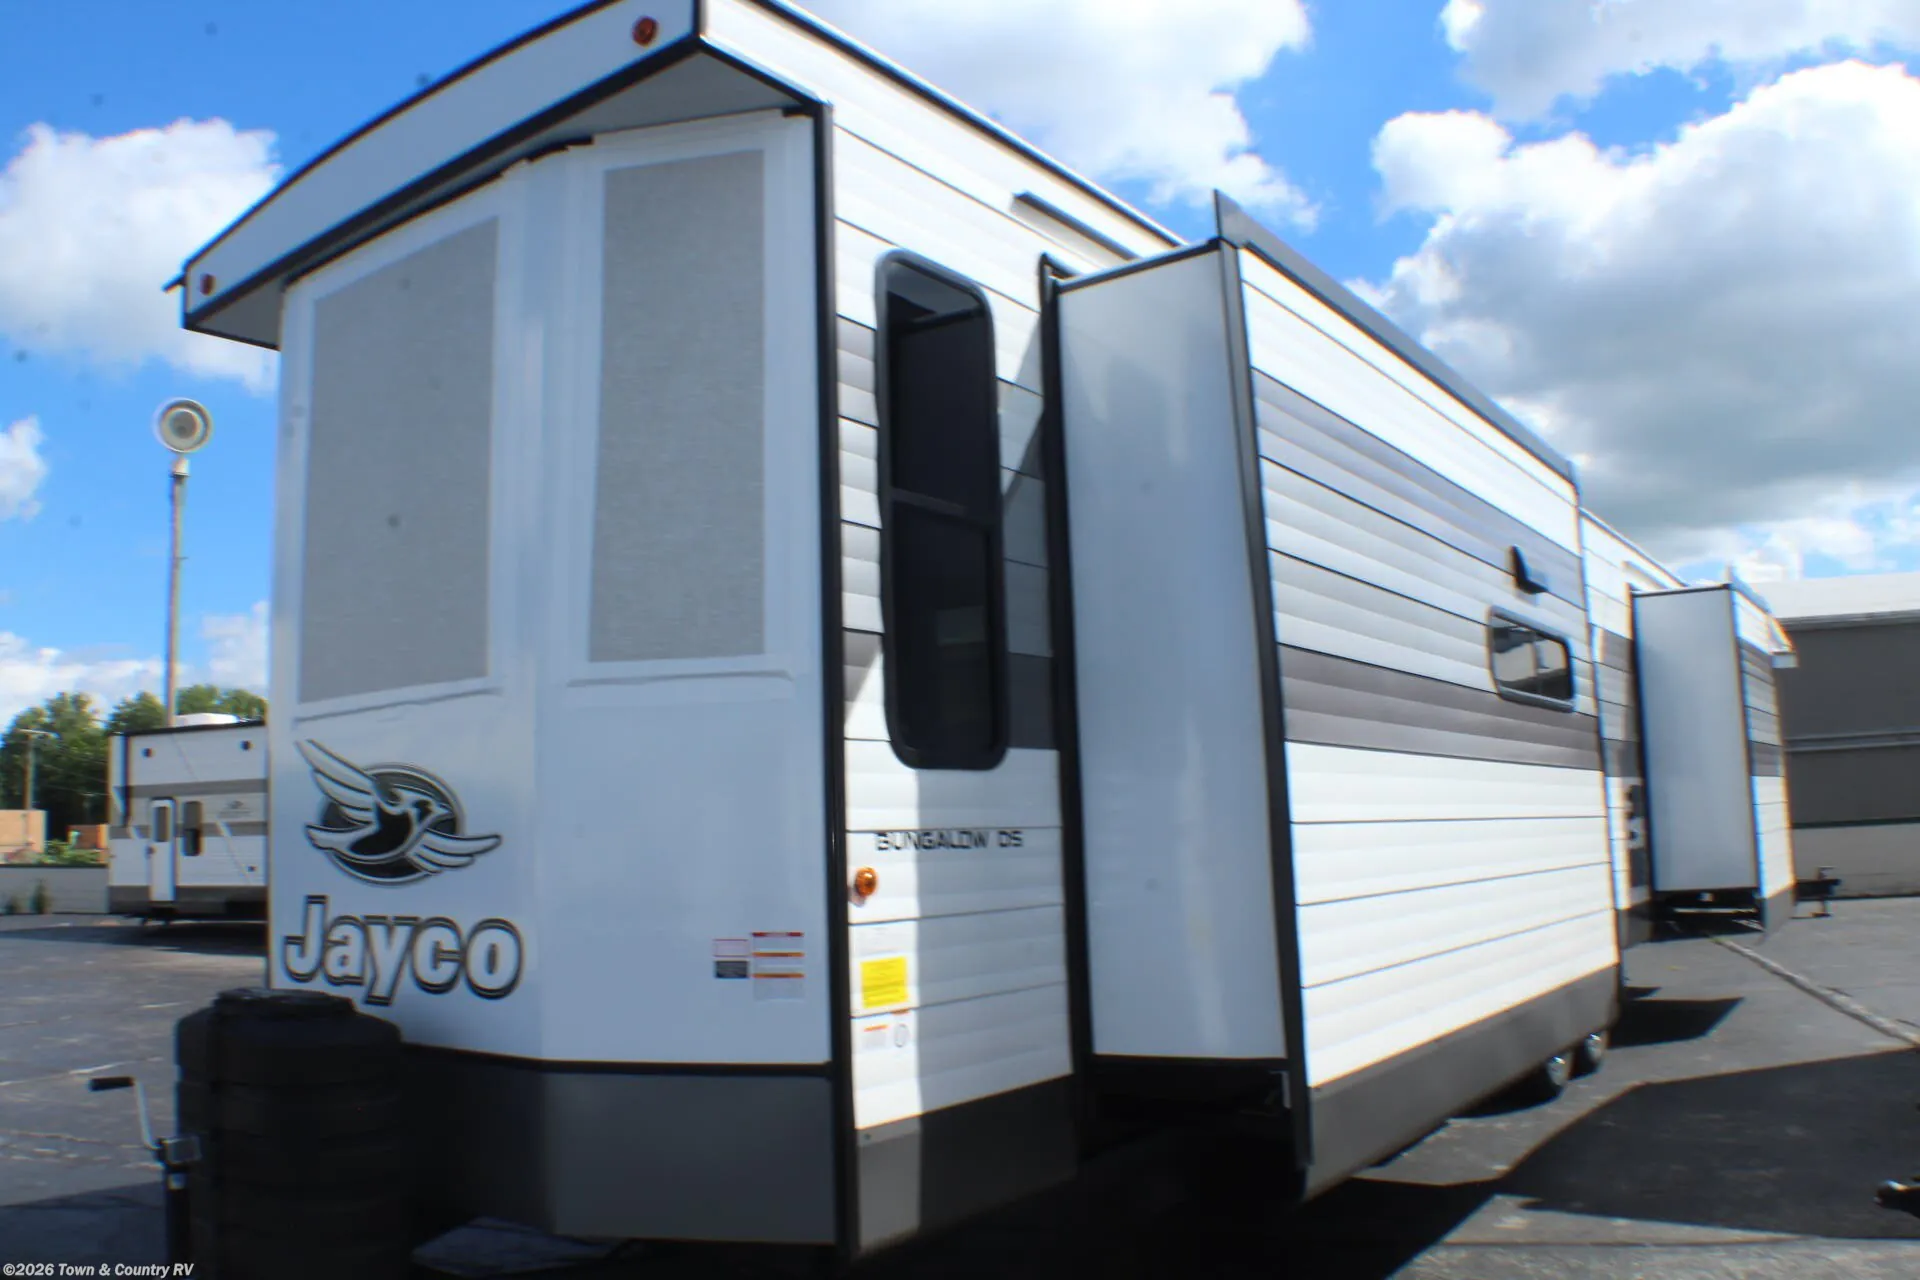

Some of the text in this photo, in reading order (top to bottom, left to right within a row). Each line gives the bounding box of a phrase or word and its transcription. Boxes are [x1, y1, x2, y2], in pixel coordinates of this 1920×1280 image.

[876, 829, 1024, 851] BUNGALOW DS
[283, 895, 524, 1006] Jayco
